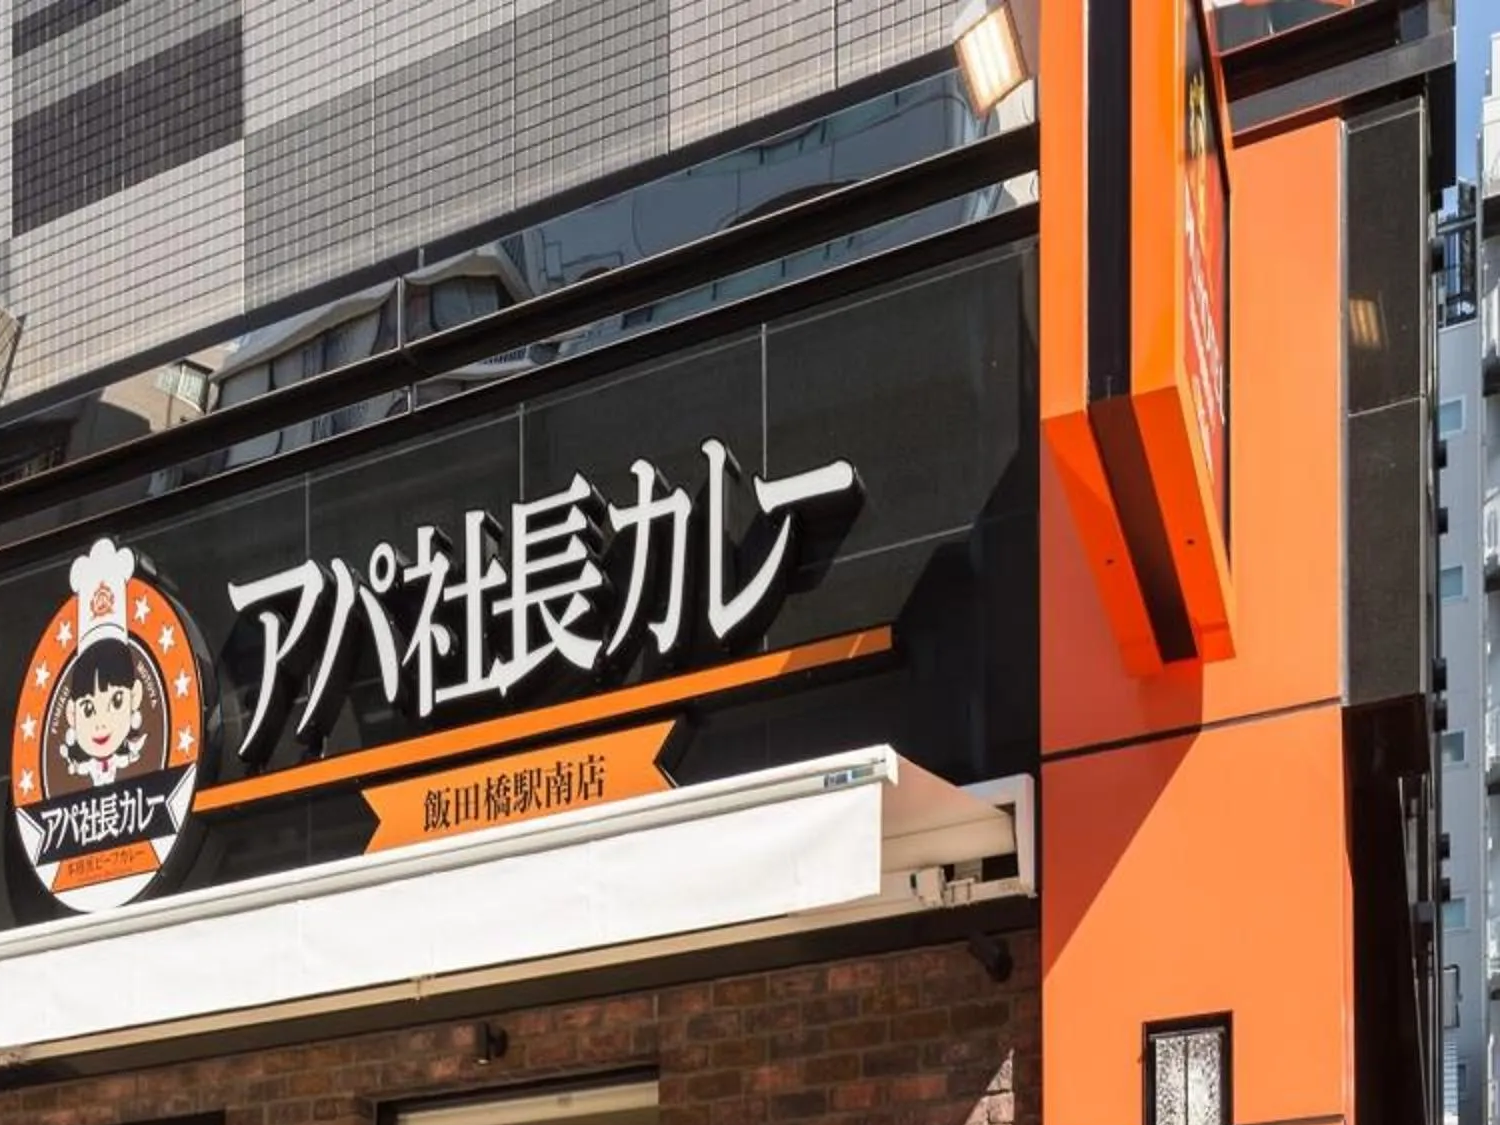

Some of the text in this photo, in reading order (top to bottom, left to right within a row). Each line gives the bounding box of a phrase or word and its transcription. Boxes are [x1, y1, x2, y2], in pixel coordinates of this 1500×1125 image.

[227, 437, 853, 758] アパ社長カレー
[41, 788, 165, 854] アパ社長カレー
[423, 753, 607, 832] 飯田橋駅南店
